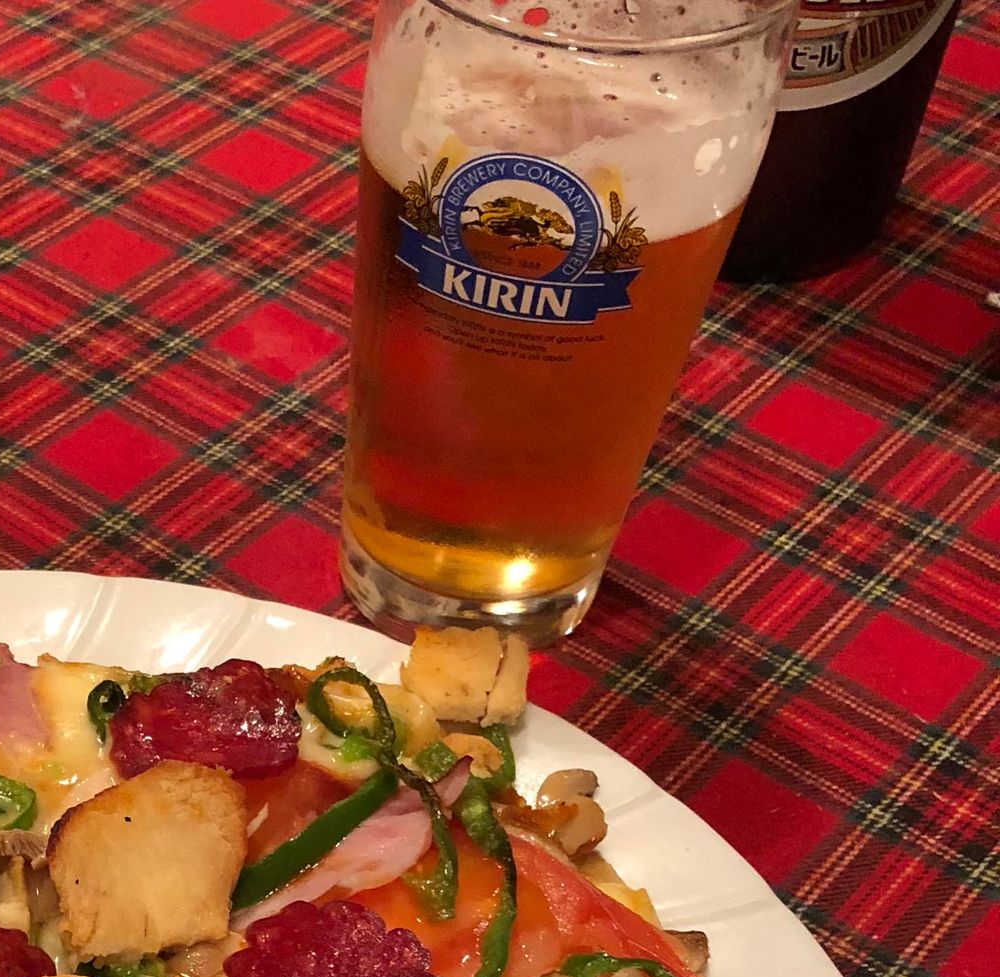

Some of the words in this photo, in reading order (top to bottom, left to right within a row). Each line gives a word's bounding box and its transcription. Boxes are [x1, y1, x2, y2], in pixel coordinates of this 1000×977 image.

[791, 44, 839, 71] ビール
[447, 162, 506, 207] BREWERY
[444, 208, 462, 251] KIRIN
[562, 221, 594, 276] LIMITED
[442, 263, 573, 318] KIRIN
